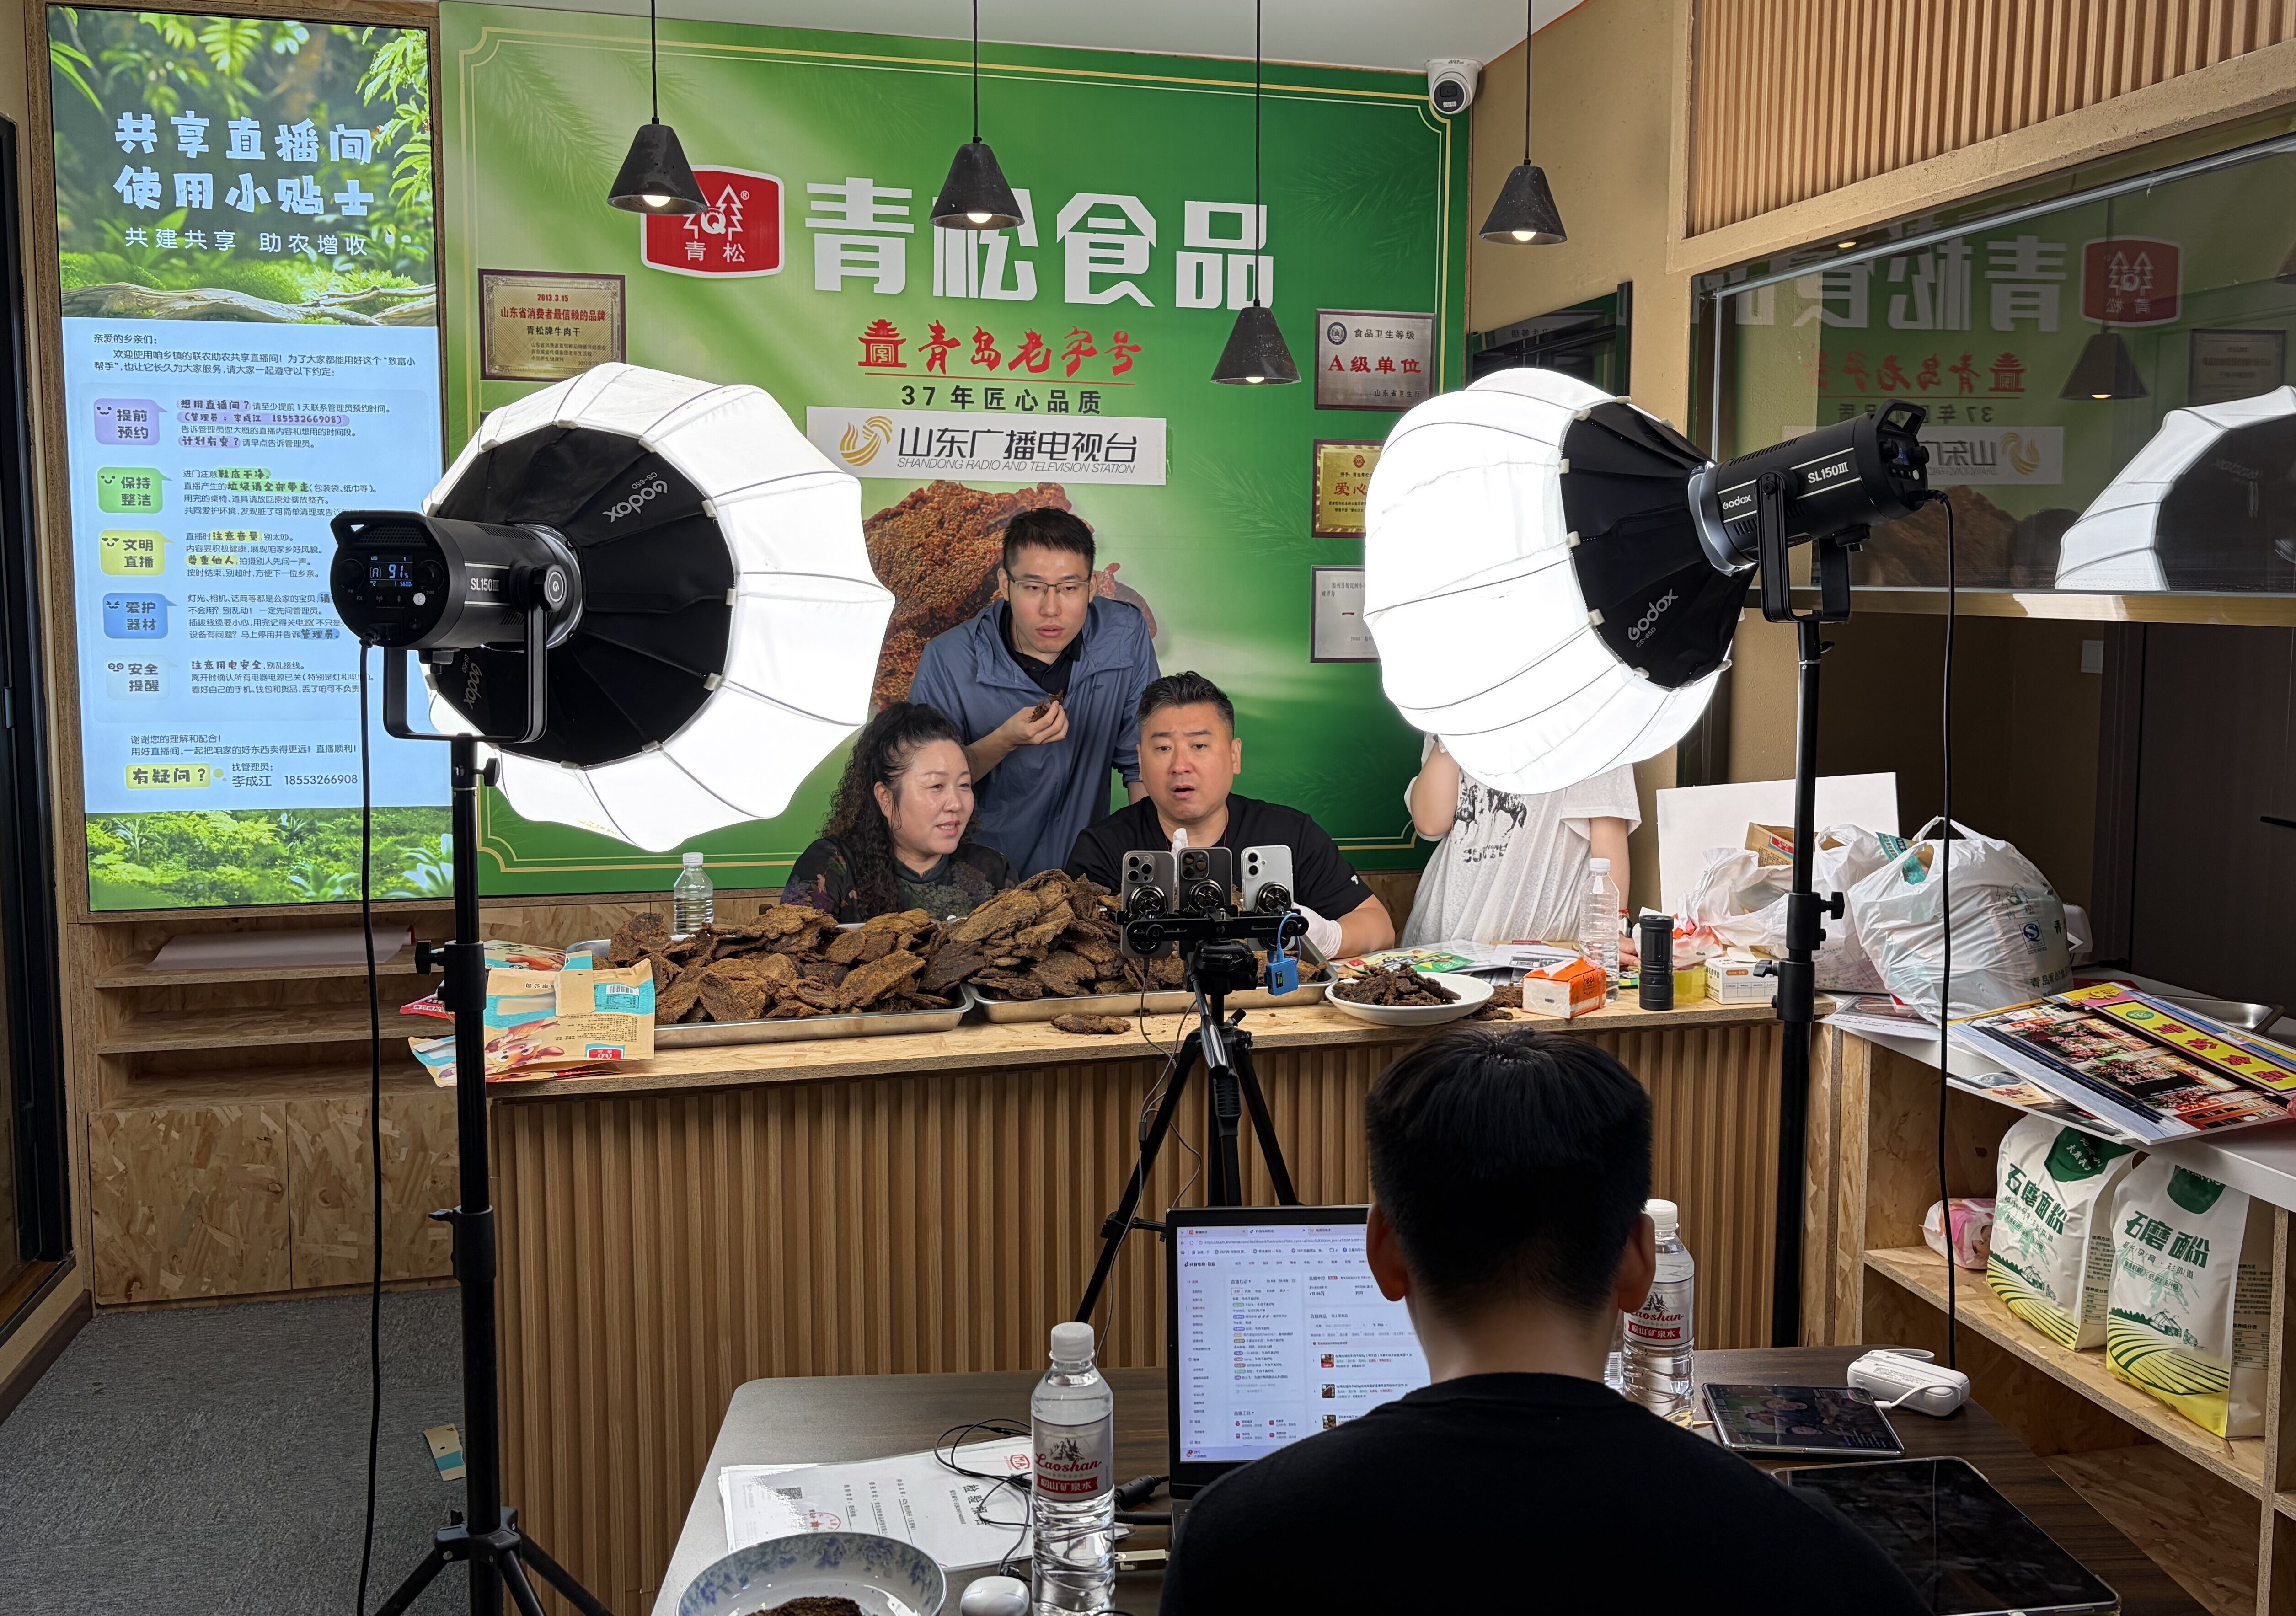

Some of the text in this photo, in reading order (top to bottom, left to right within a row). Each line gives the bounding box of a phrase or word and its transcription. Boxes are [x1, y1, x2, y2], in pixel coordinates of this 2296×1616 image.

[115, 110, 372, 164] 共享直播间
[114, 165, 373, 216] 使用小贴士
[125, 227, 368, 257] 共建共享 助农增收
[805, 177, 1274, 310] 青松食品
[685, 241, 746, 263] 青松
[537, 294, 568, 302] 2013.3.15
[501, 307, 606, 321] 山东省消费者最信赖的品牌
[526, 326, 581, 337] 青松牌牛肉干
[1354, 328, 1415, 340] 食品卫生等级
[918, 319, 1142, 377] 青岛老字号
[1328, 354, 1421, 374] A级单位
[1374, 389, 1421, 398] 山东省卫生厅
[117, 409, 147, 422] 提前
[118, 426, 148, 439] 预约
[898, 426, 1137, 464] 山东广播电视台
[897, 458, 1136, 474] SHANDONG RADIO AND TELEVISION STATION
[121, 476, 151, 489] 保持
[1334, 482, 1367, 496] 爱心
[121, 493, 151, 506] 整洁
[602, 480, 668, 523] Godox
[1722, 494, 1751, 510] Godox
[123, 539, 153, 551] 文明
[124, 556, 154, 568] 直播
[126, 601, 156, 614] 爱护
[1628, 589, 1679, 641] Godox
[127, 618, 156, 631] 器材
[128, 663, 159, 675] 安全
[129, 680, 160, 692] 提醒
[463, 663, 483, 710] Godox
[232, 774, 358, 787] 李成江 18553266908
[2005, 1163, 2064, 1235] 石磨面粉
[2124, 1210, 2210, 1268] 石磨面粉
[1035, 1453, 1102, 1472] Laoshan
